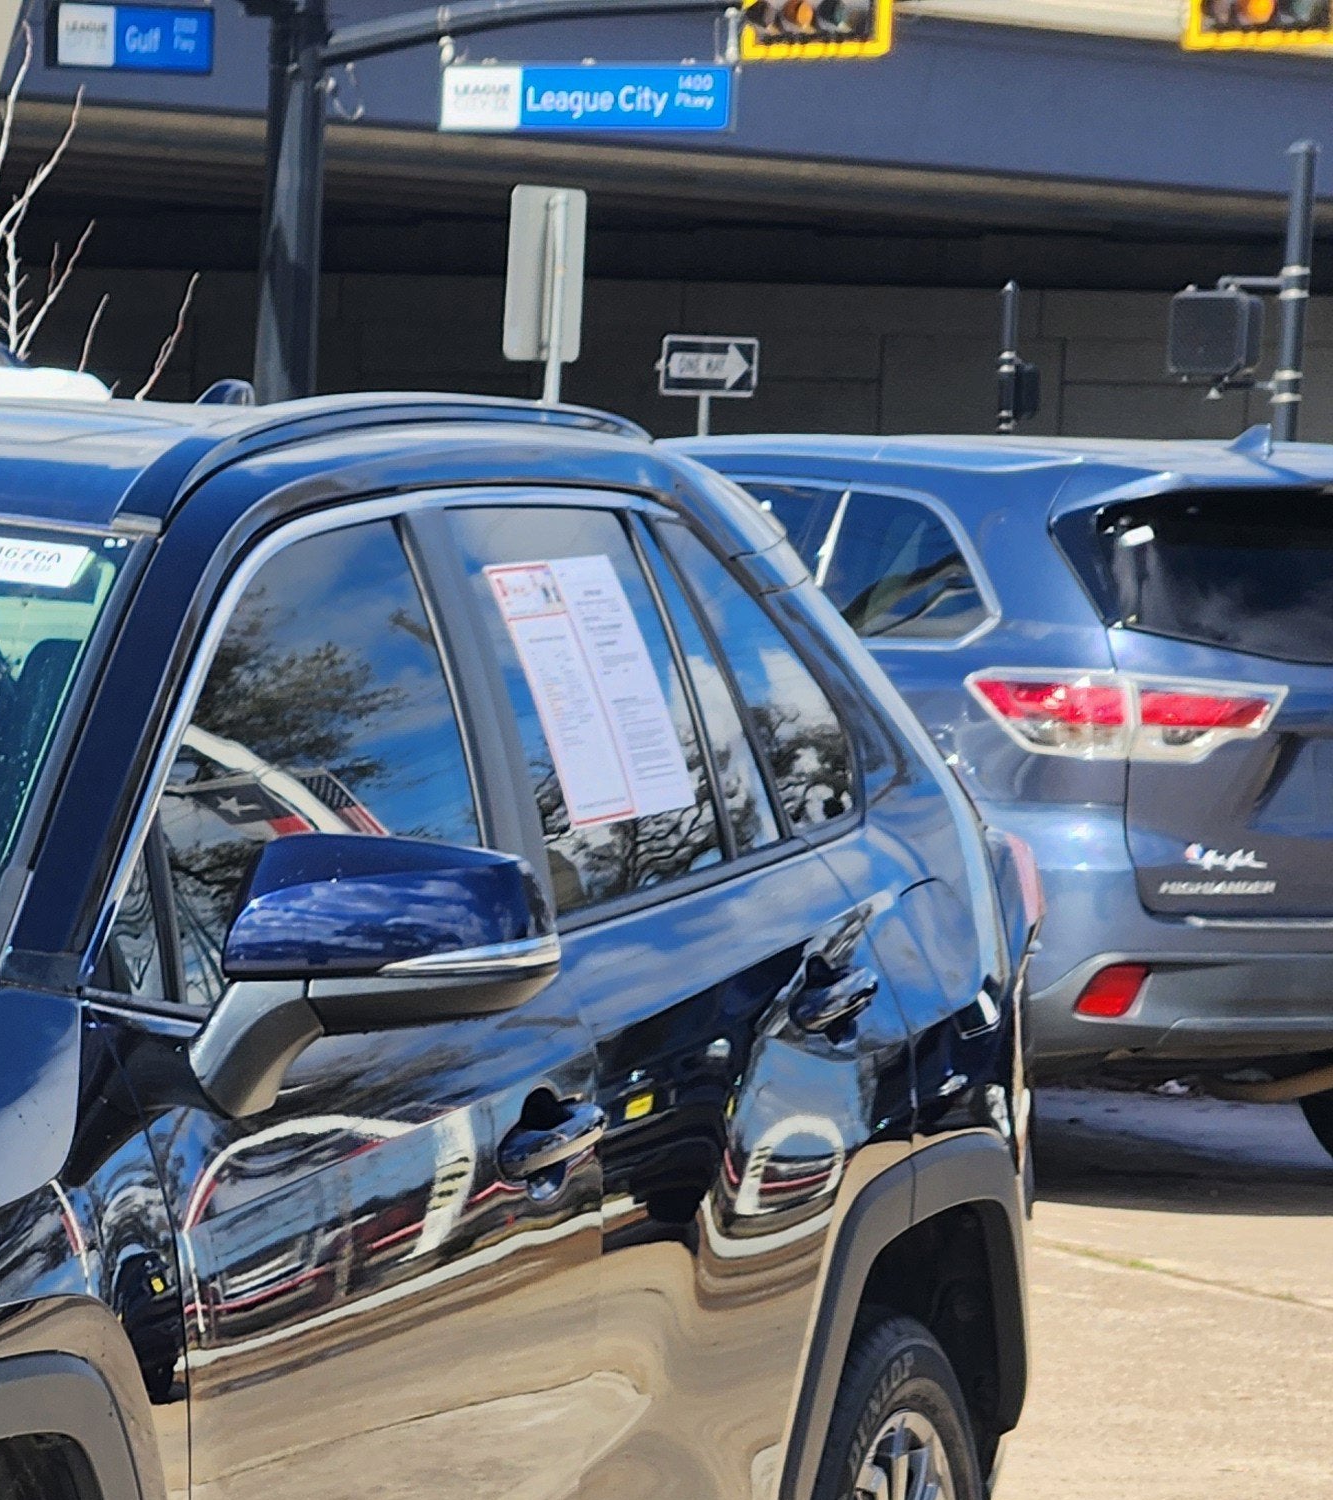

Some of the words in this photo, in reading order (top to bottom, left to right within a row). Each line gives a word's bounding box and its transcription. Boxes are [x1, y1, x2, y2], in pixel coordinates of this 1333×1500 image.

[124, 24, 161, 54] Gulf
[526, 86, 615, 119] League
[618, 85, 669, 118] City
